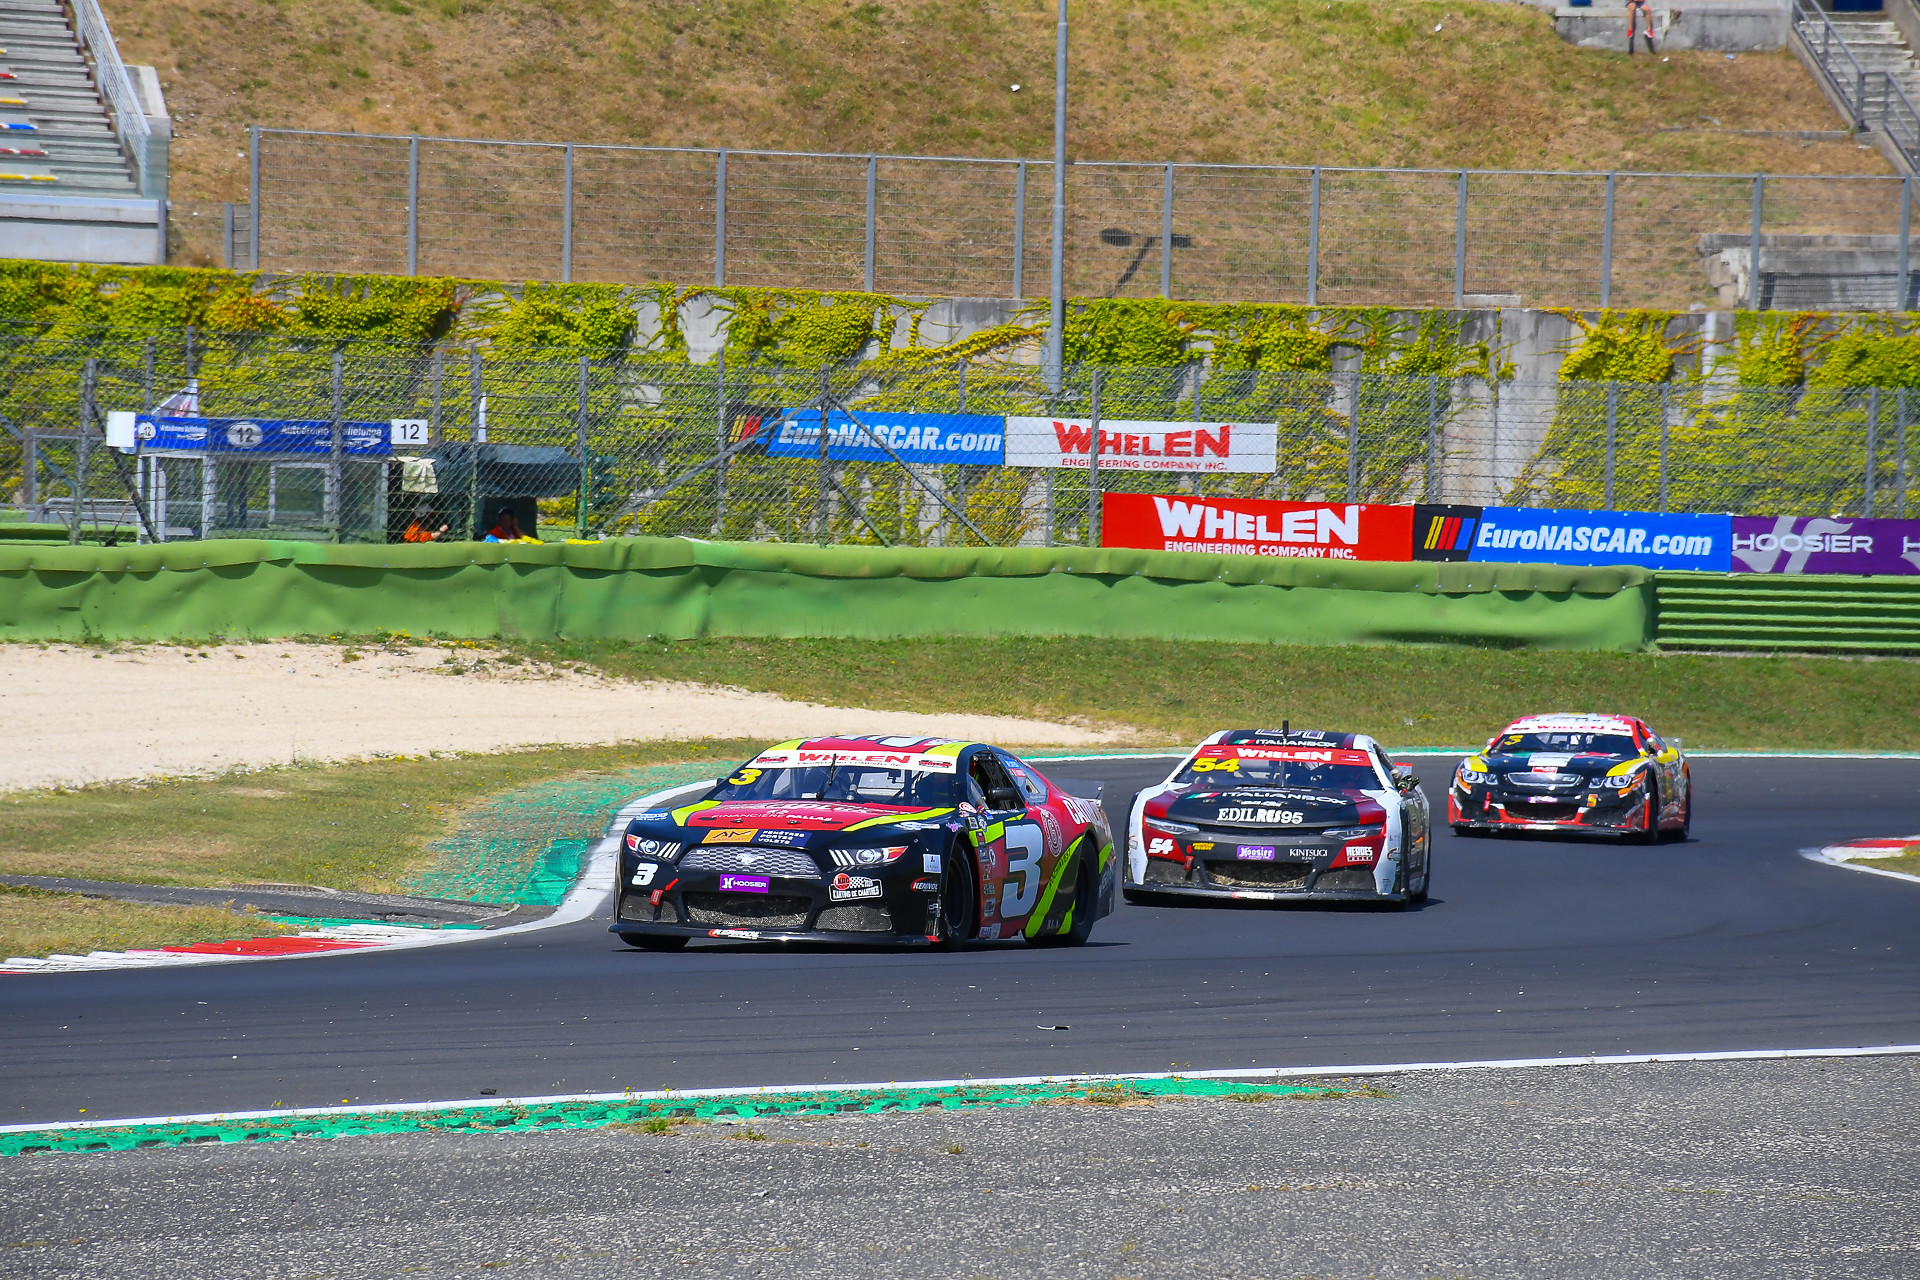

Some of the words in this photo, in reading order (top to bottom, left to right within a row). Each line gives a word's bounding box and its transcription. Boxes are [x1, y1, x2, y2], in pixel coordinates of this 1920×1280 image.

[237, 427, 254, 443] 12
[400, 423, 420, 440] 12
[778, 420, 1002, 451] EuroNASCAR.com
[1053, 421, 1230, 458] WHELEN
[1143, 460, 1202, 470] COMPANY
[1153, 496, 1360, 545] WHELEN
[1476, 522, 1713, 556] EuroNASCAR.com
[1732, 533, 1874, 554] HOOSIER
[1165, 541, 1255, 555] ENGINEERING
[1259, 544, 1326, 558] COMPANY
[1329, 548, 1357, 560] INC.
[799, 753, 911, 764] WHELEN
[1237, 748, 1333, 761] WHELEN
[1192, 758, 1239, 772] 54
[729, 769, 763, 785] 3
[1222, 792, 1348, 805] ITALIANBOX
[1149, 838, 1174, 854] 54
[1289, 848, 1328, 857] KINTSUGI
[632, 862, 659, 886] 3
[1000, 823, 1044, 918] 3
